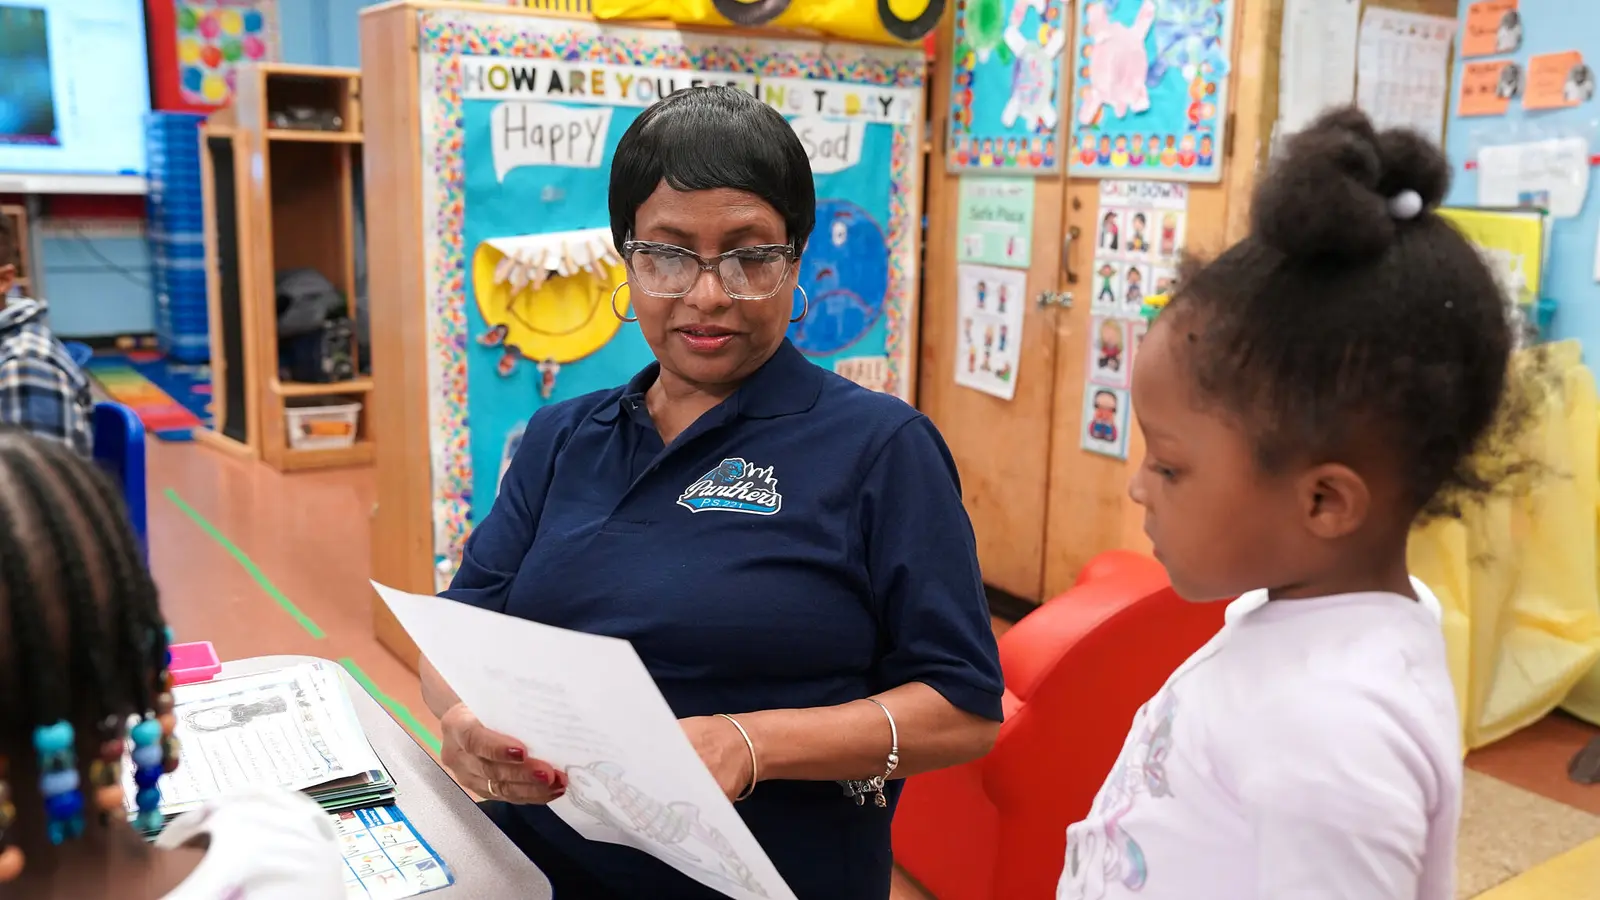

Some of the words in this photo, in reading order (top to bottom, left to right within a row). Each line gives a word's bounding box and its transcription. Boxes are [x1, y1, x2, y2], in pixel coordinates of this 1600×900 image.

[463, 64, 536, 92] HOW
[547, 69, 605, 96] ARE
[616, 72, 675, 100] YOU
[504, 105, 603, 166] Happy
[801, 123, 849, 161] Sad
[684, 479, 777, 507] Panthers
